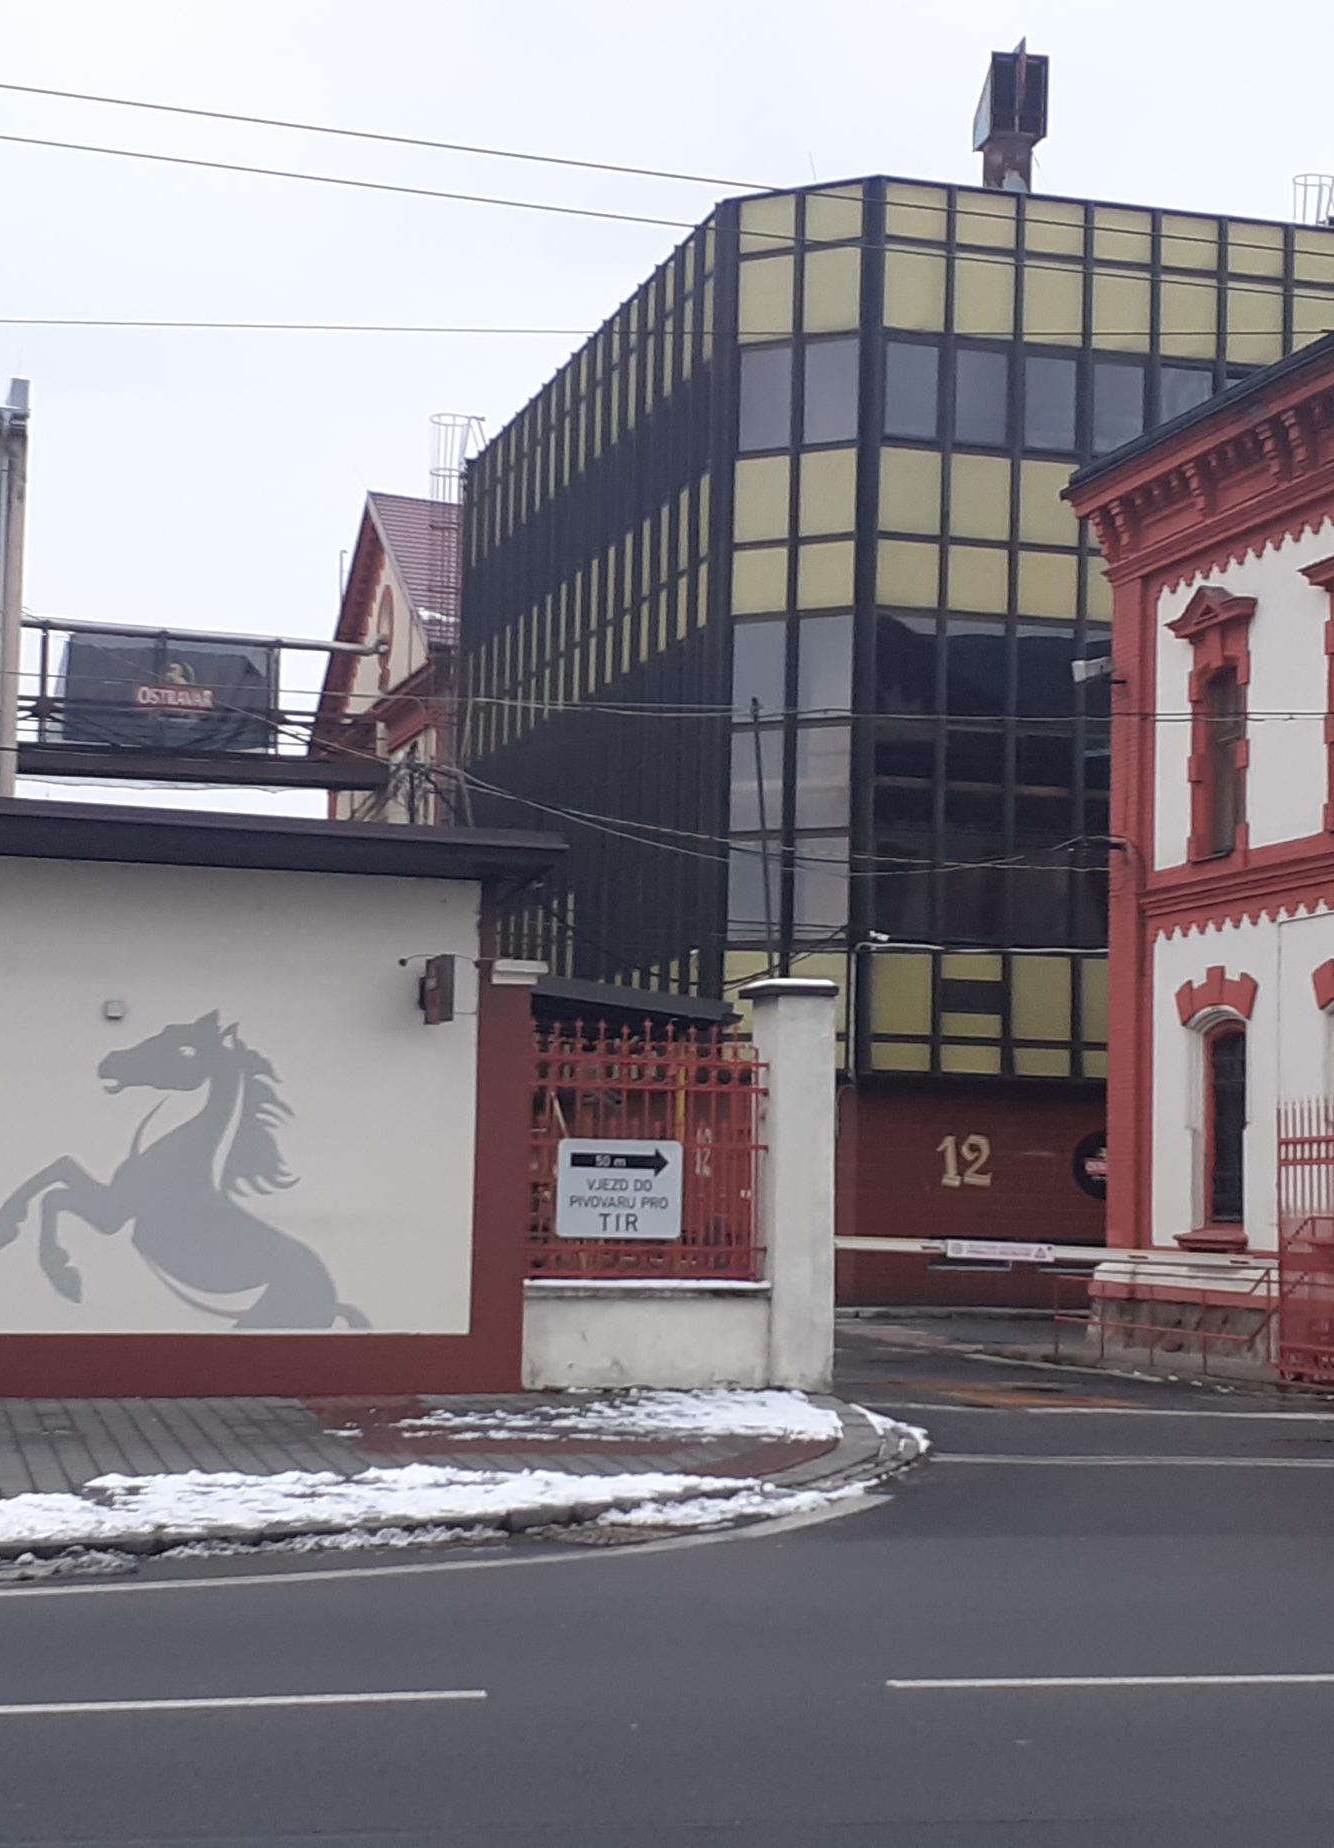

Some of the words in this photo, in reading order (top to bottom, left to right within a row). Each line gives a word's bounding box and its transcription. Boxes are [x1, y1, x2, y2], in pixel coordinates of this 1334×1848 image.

[595, 1155, 611, 1168] 50
[613, 1157, 627, 1168] m
[937, 1134, 993, 1188] 12
[587, 1178, 629, 1192] VJEZD
[633, 1179, 653, 1192] DO
[569, 1196, 636, 1209] PIVOVARU
[640, 1197, 669, 1209] PRO
[598, 1213, 639, 1232] TIR
